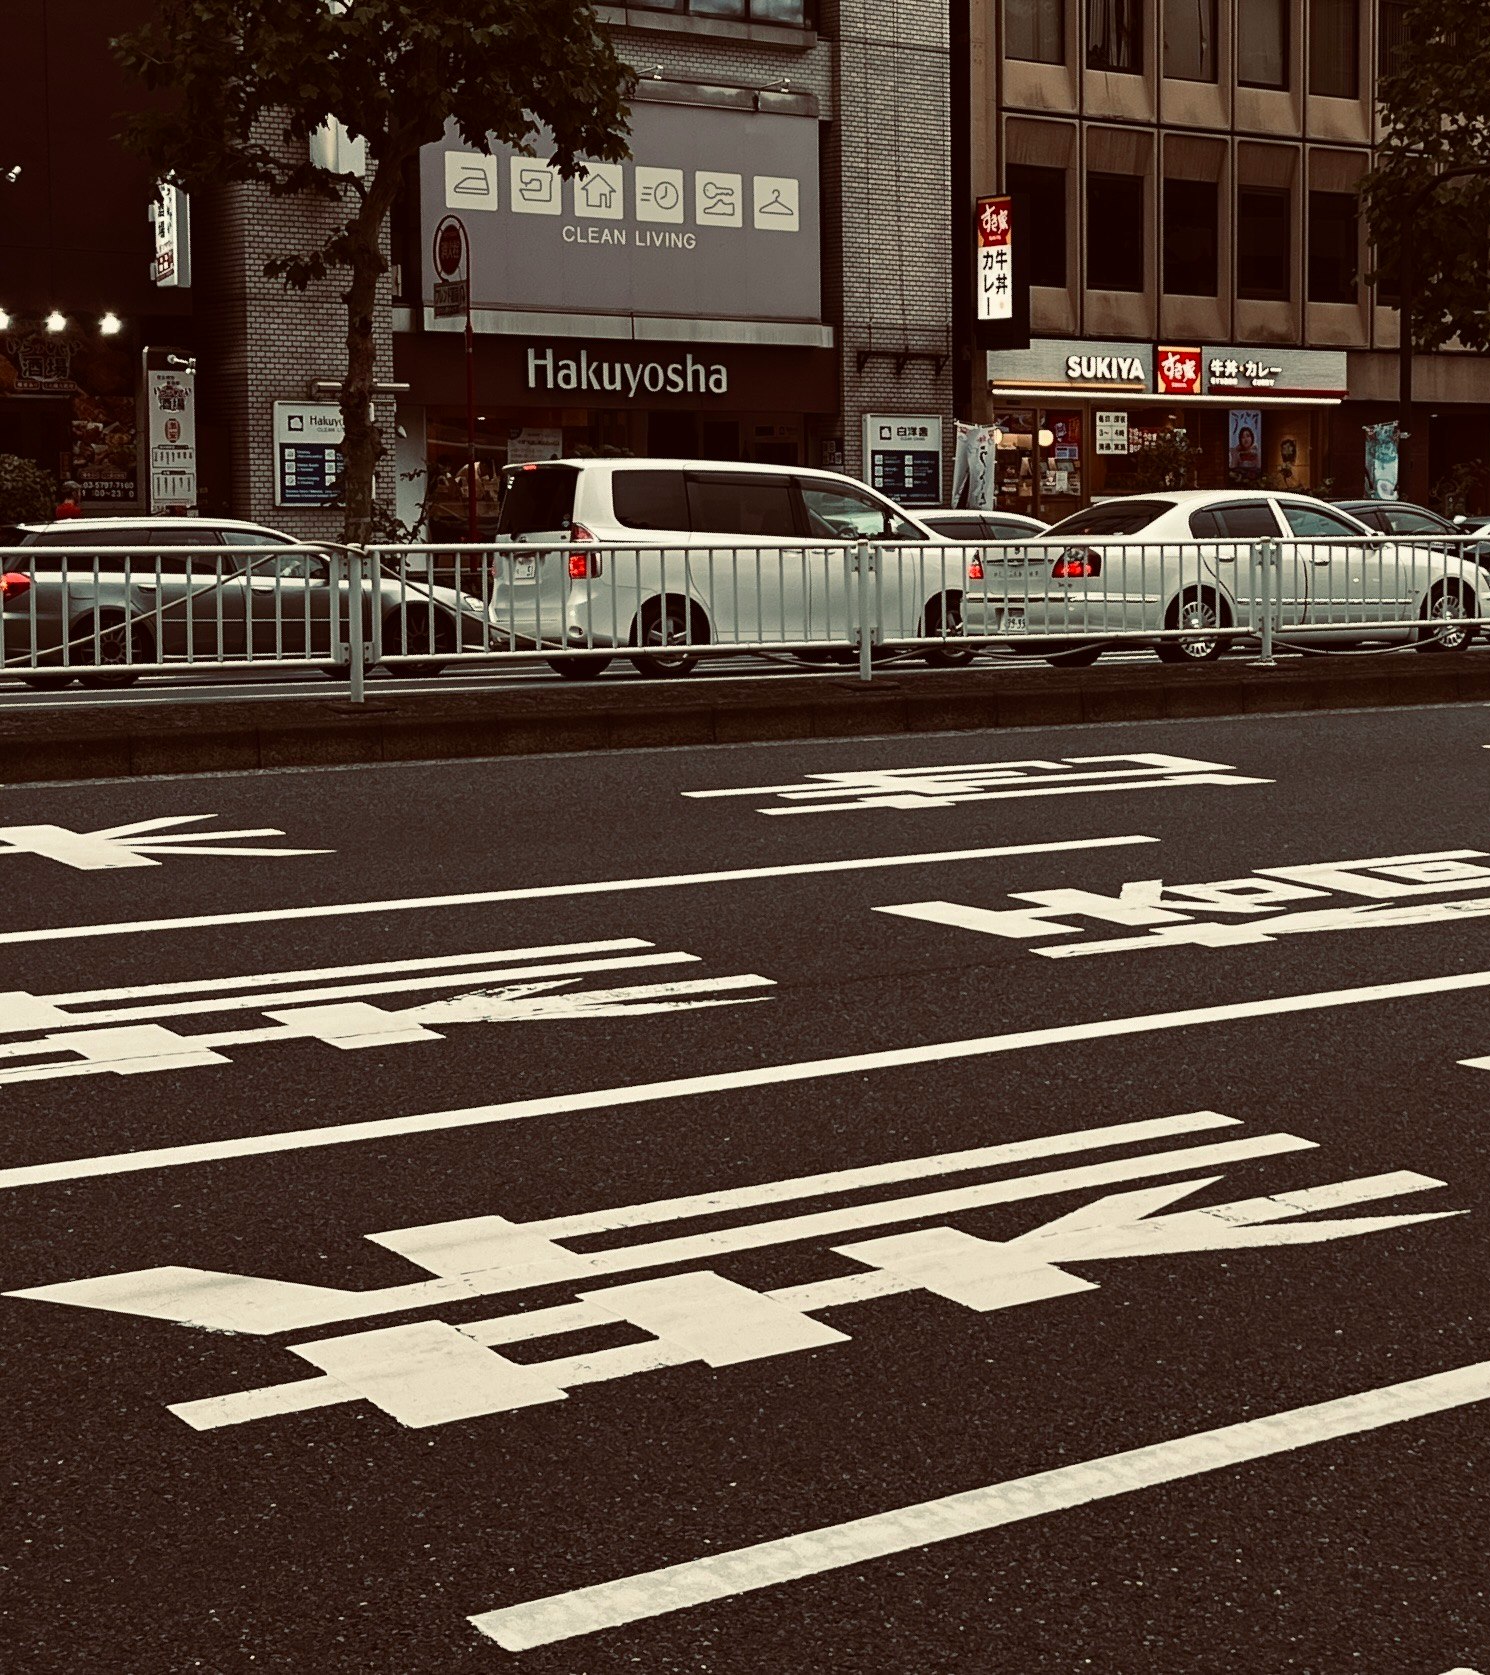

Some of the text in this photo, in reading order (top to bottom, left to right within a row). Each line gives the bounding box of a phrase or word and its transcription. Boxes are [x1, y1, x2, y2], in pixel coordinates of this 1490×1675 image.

[562, 225, 697, 250] CLEAN LIVING
[983, 251, 994, 316] カレー
[996, 249, 1008, 294] 牛丼
[527, 348, 728, 398] Hakuyosha
[1067, 355, 1145, 380] SUKIYA
[1161, 352, 1196, 383] すき家
